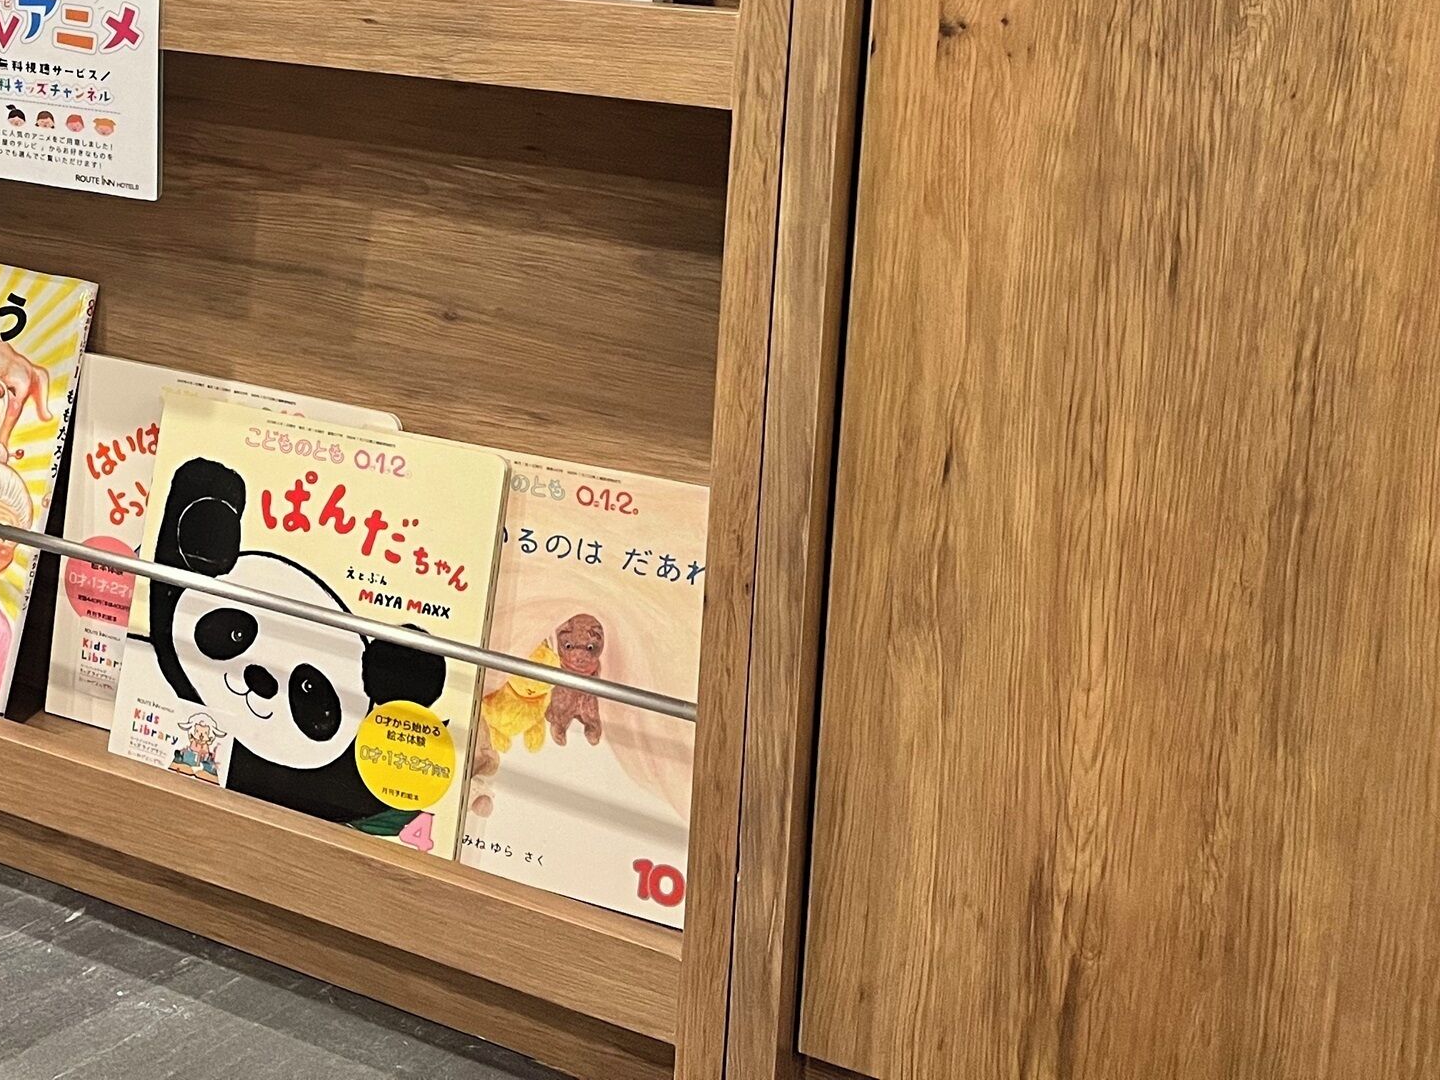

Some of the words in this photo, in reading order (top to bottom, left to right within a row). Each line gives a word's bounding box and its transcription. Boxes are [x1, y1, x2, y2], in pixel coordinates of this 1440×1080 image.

[75, 173, 100, 185] ROUTE
[116, 182, 140, 191] HOTELS
[51, 389, 75, 479] ももたろう
[245, 426, 345, 464] こどものとも
[261, 470, 469, 592] ぱんだちゃん
[359, 588, 403, 610] MAYA
[406, 599, 451, 619] MAXX
[82, 637, 108, 653] Kids
[133, 708, 160, 725] Kids
[375, 714, 441, 737] 0才から始める
[131, 721, 179, 745] Library
[386, 729, 427, 748] 絵本体験
[381, 786, 420, 802] 月刊予約絵本
[398, 811, 435, 853] 4
[524, 851, 544, 867] さく
[632, 858, 686, 907] 10
